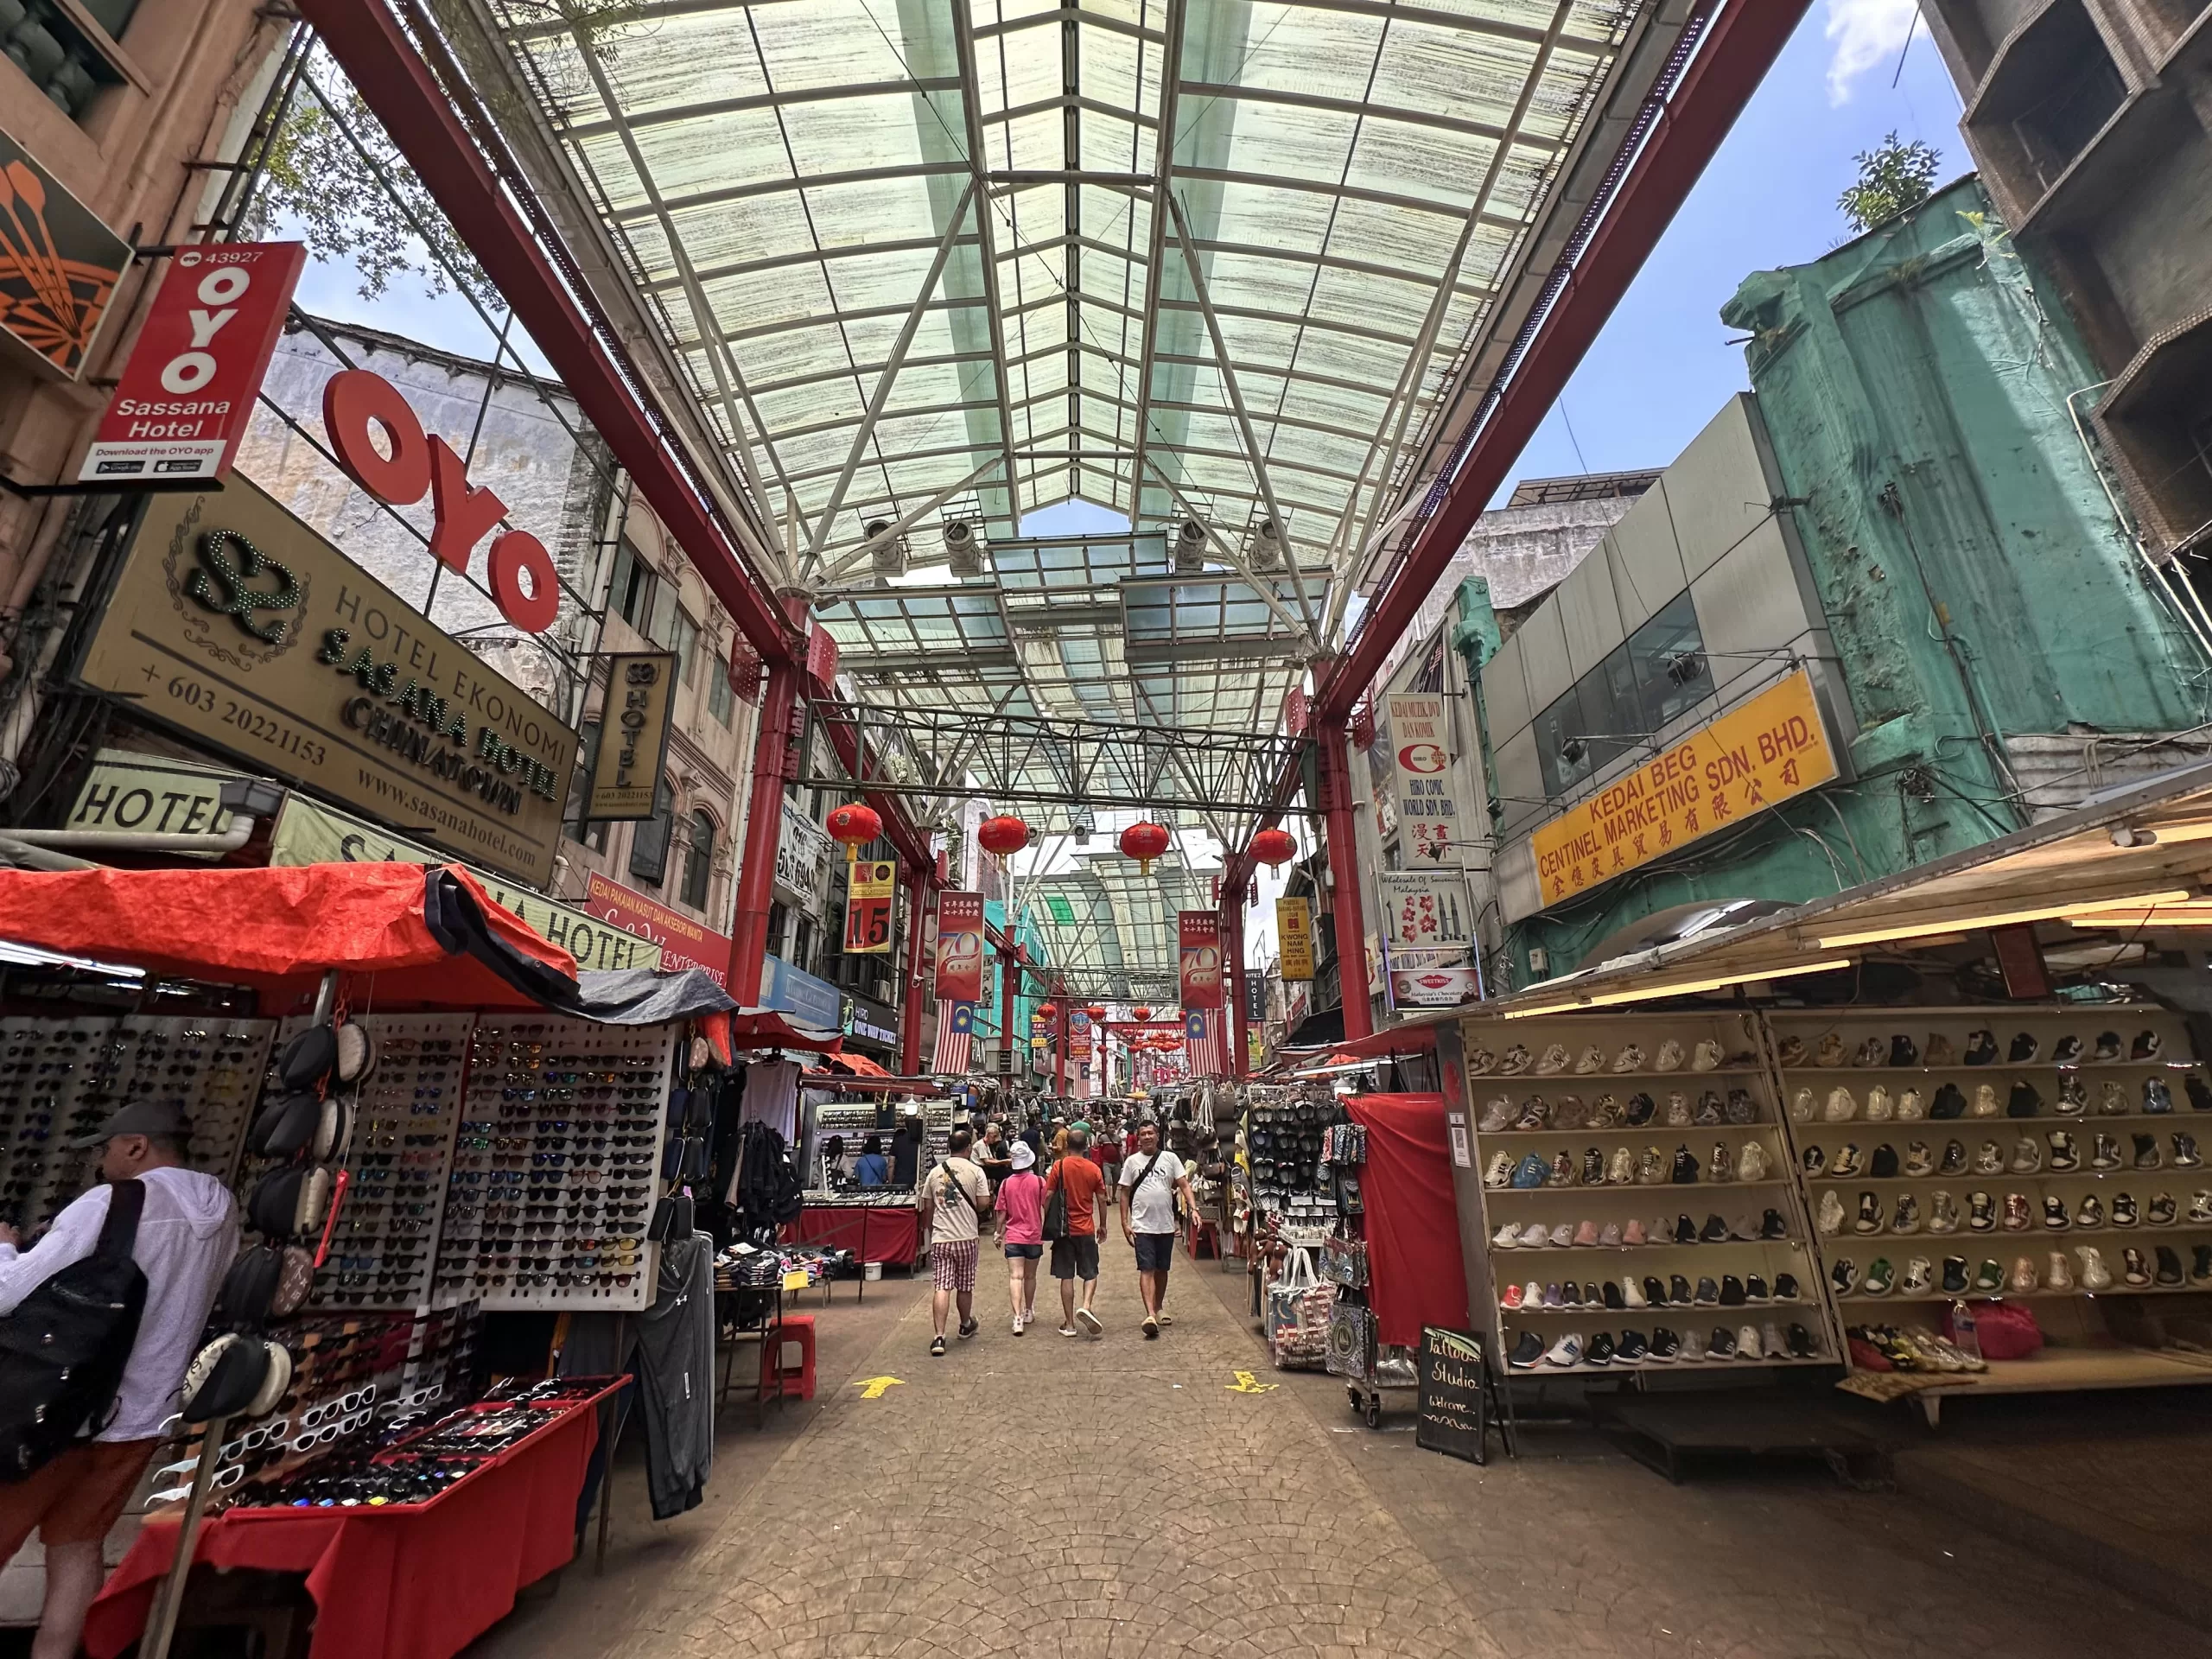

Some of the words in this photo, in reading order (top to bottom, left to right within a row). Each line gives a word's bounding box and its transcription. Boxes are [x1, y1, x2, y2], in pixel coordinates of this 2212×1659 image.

[206, 251, 263, 264] 43927
[161, 266, 251, 394] OYO
[117, 398, 231, 416] Sassana
[128, 420, 204, 438] Hotel
[95, 448, 148, 456] Download
[322, 369, 560, 633] OYO
[335, 585, 439, 682] HOTEL
[452, 671, 566, 766] EKONOMI
[168, 677, 216, 713] 603
[221, 701, 327, 766] 20221153
[321, 627, 468, 748] SASANA
[475, 726, 559, 802] HOTEL
[1391, 702, 1409, 718] KEDAI
[1428, 702, 1440, 717] DVD
[616, 690, 647, 787] HOTEL
[1402, 722, 1414, 738] DAN
[1414, 722, 1435, 737] KOMIK
[341, 696, 523, 816] CHINATOWN
[1409, 779, 1424, 795] HIRO
[1426, 779, 1444, 795] COMIC
[1540, 830, 1602, 879] CENTINEL
[1603, 774, 1700, 846] MARKETING
[1705, 745, 1756, 791] SDN.
[1758, 715, 1816, 766] BHD.
[1589, 780, 1645, 823] KEDAI
[1651, 745, 1697, 790] BEG
[358, 768, 537, 868] www.sasanahotel.com
[1403, 799, 1424, 816] WORLD
[1426, 799, 1440, 816] SDN.
[1441, 800, 1456, 816] BHD.
[1412, 823, 1449, 841] 漫畫
[1552, 758, 1802, 898] 金億皮具貿易有限公司
[1381, 875, 1417, 884] Wholesale
[1418, 876, 1427, 885] Of
[1393, 885, 1430, 896] Malaysia
[590, 879, 610, 902] KEDAI
[653, 908, 664, 925] DAN
[664, 914, 688, 938] AKSESORI
[687, 925, 703, 943] WANITA
[847, 908, 890, 944] 15
[939, 931, 980, 956] 70
[1181, 947, 1218, 969] 70
[1250, 980, 1259, 1017] HOTEL
[854, 1019, 868, 1036] ONE
